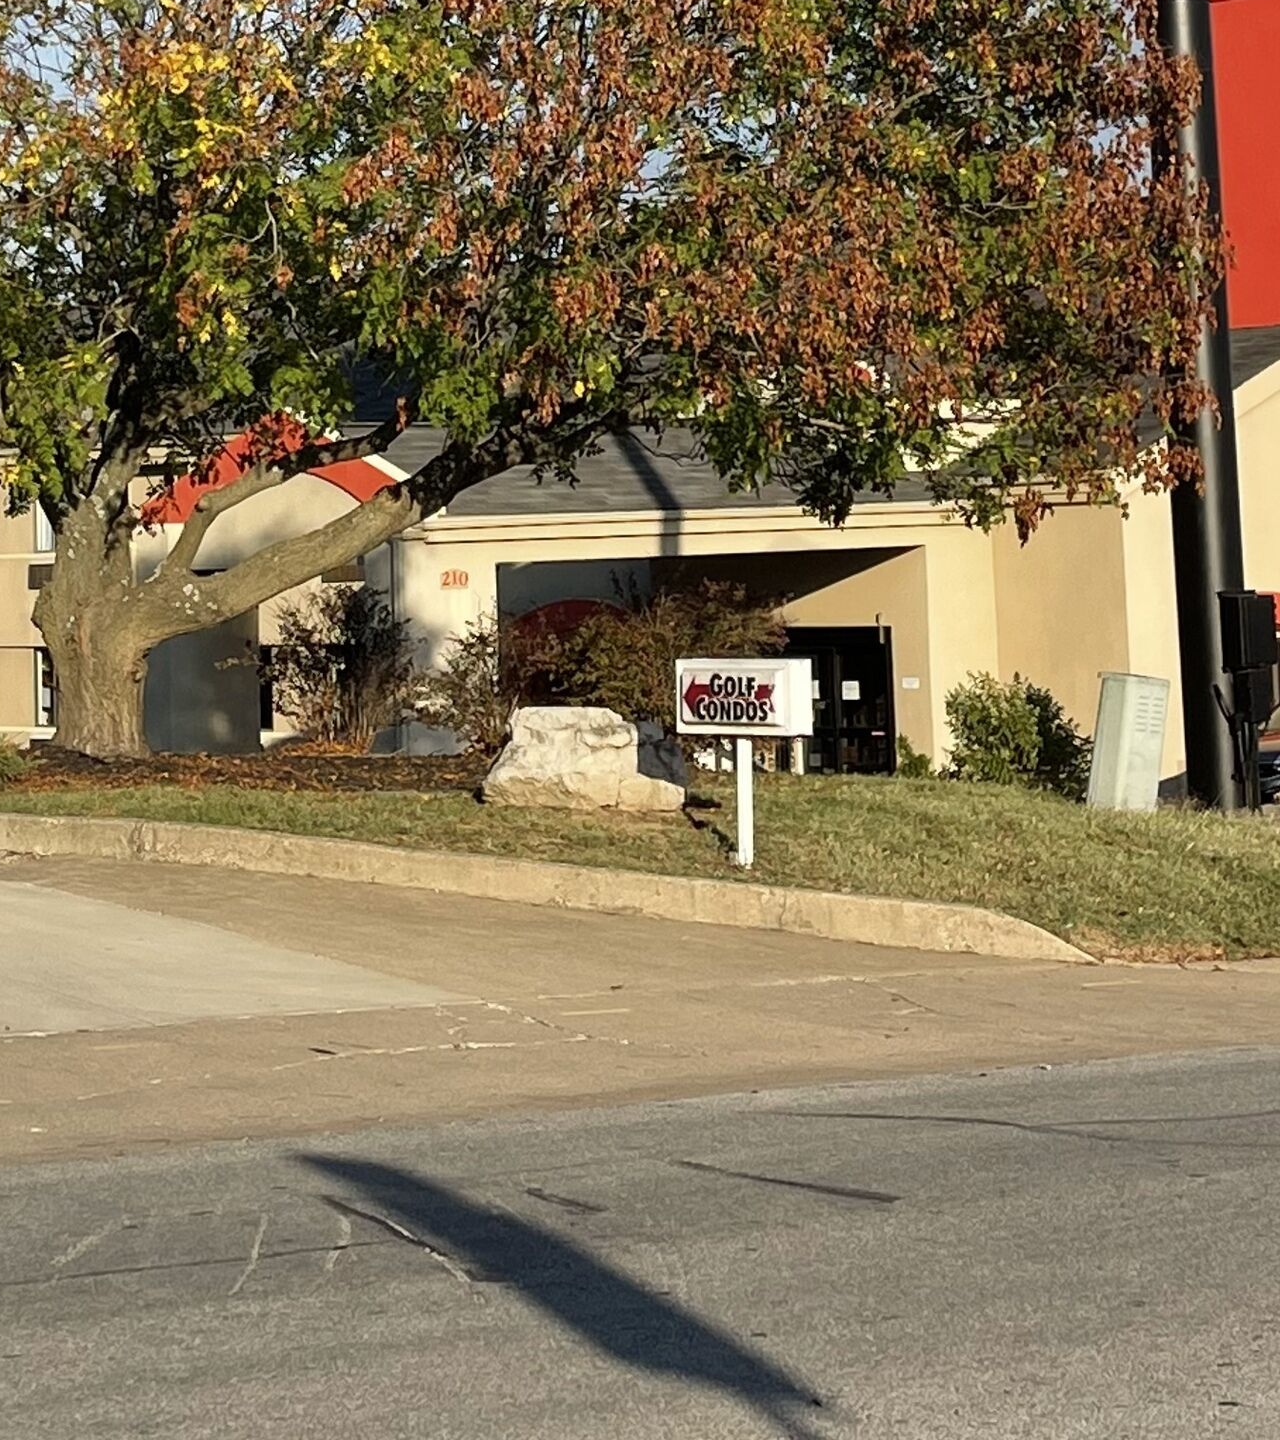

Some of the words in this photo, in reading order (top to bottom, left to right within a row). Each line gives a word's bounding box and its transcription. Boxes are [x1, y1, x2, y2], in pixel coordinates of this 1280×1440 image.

[441, 571, 469, 586] 210
[709, 673, 756, 698] GOLF
[695, 696, 768, 722] CONDOS
